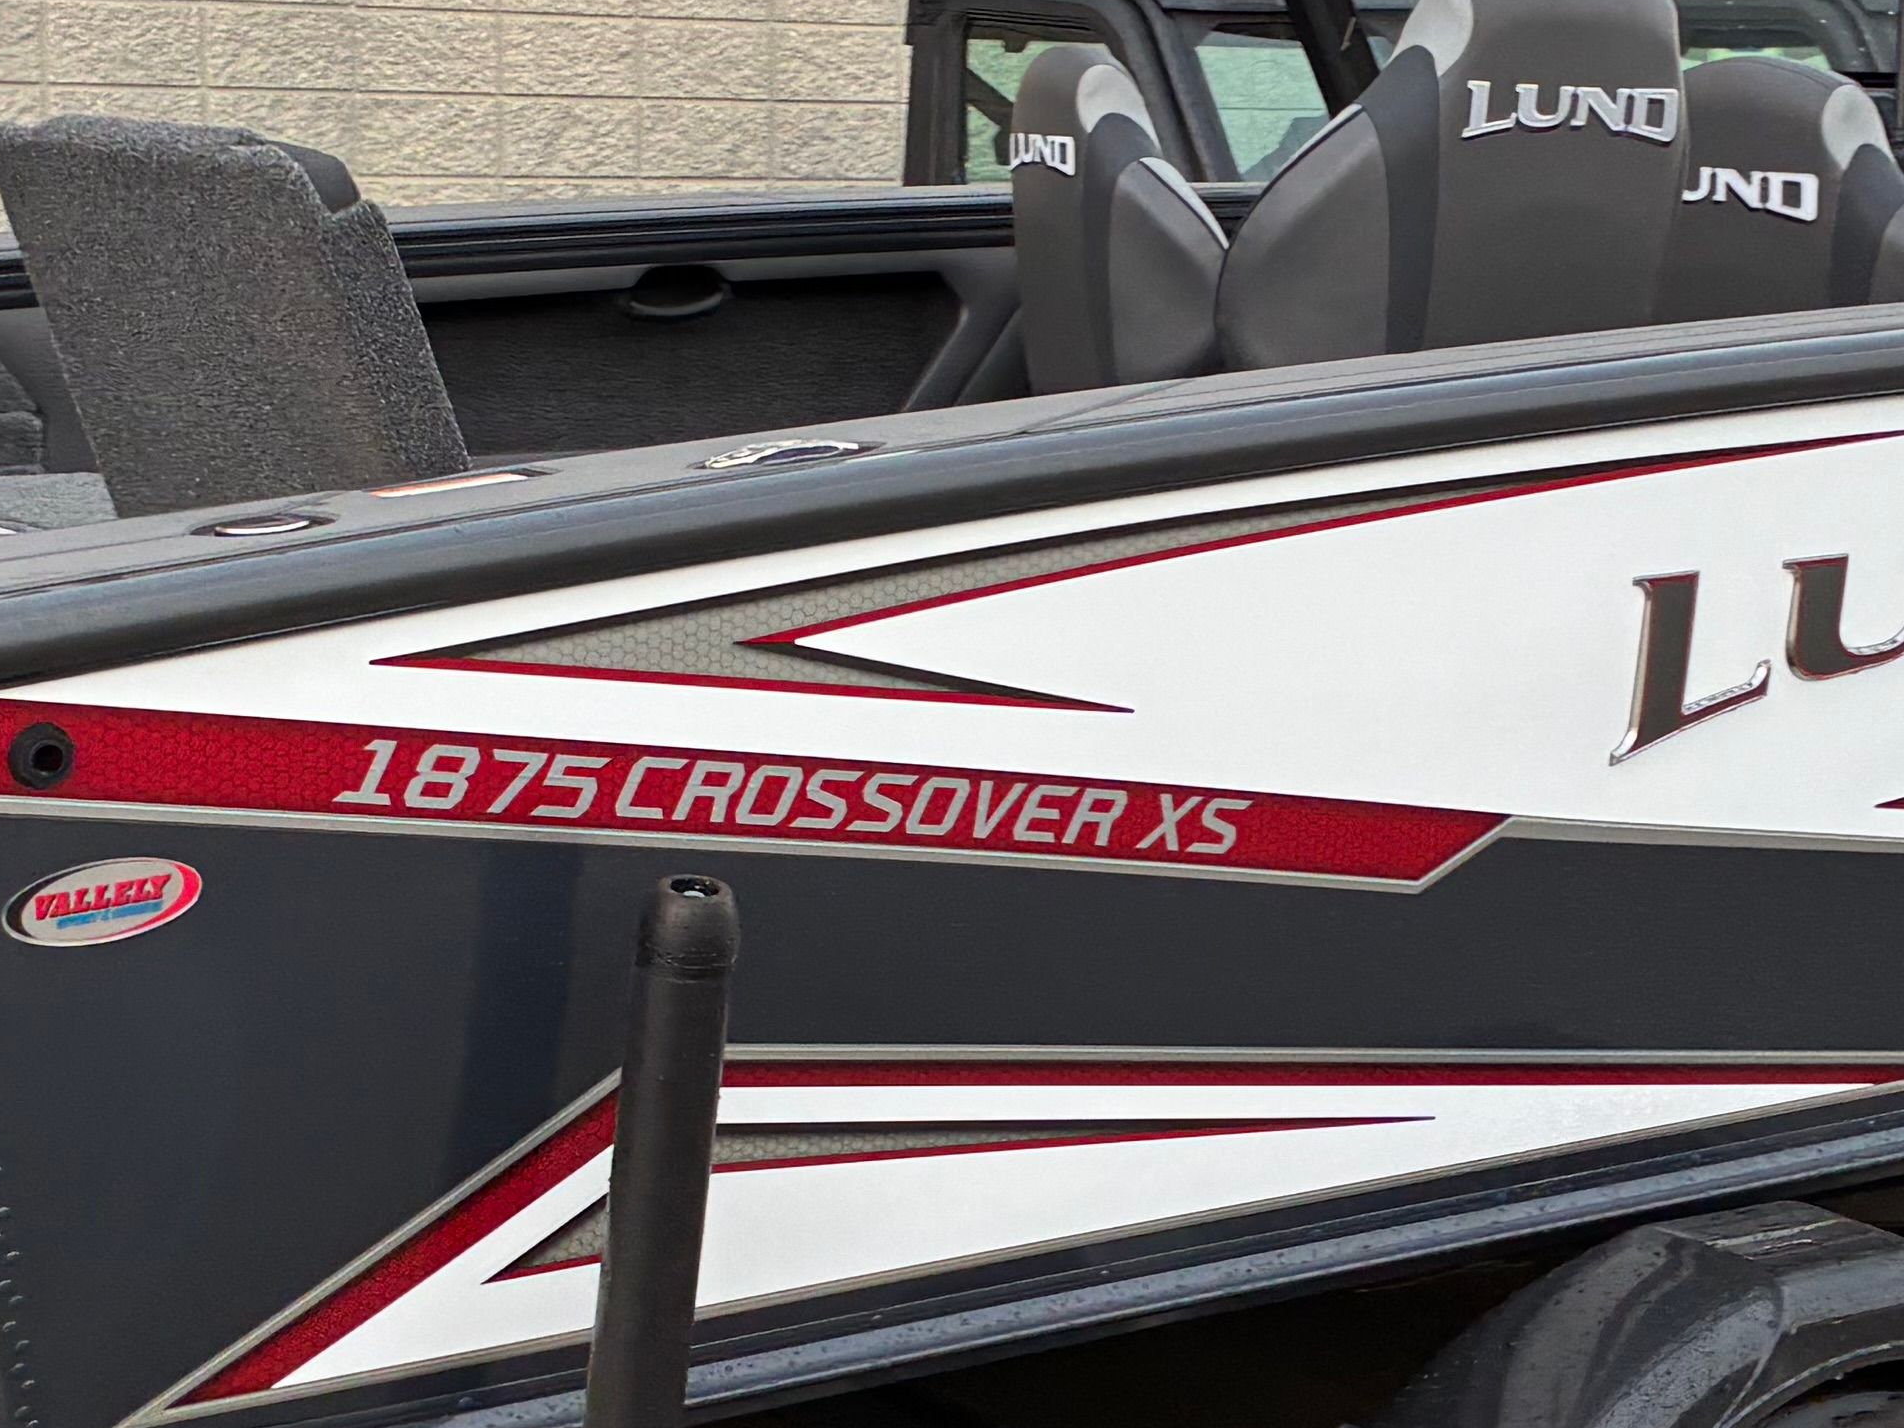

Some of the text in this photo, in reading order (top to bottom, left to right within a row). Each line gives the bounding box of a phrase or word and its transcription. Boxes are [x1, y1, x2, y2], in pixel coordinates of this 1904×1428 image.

[1460, 79, 1680, 143] LUND
[1008, 132, 1076, 177] LUND
[1680, 165, 1820, 222] UND
[331, 738, 1255, 856] 1875 CROSSOVER XS
[34, 873, 172, 921] VALLELY
